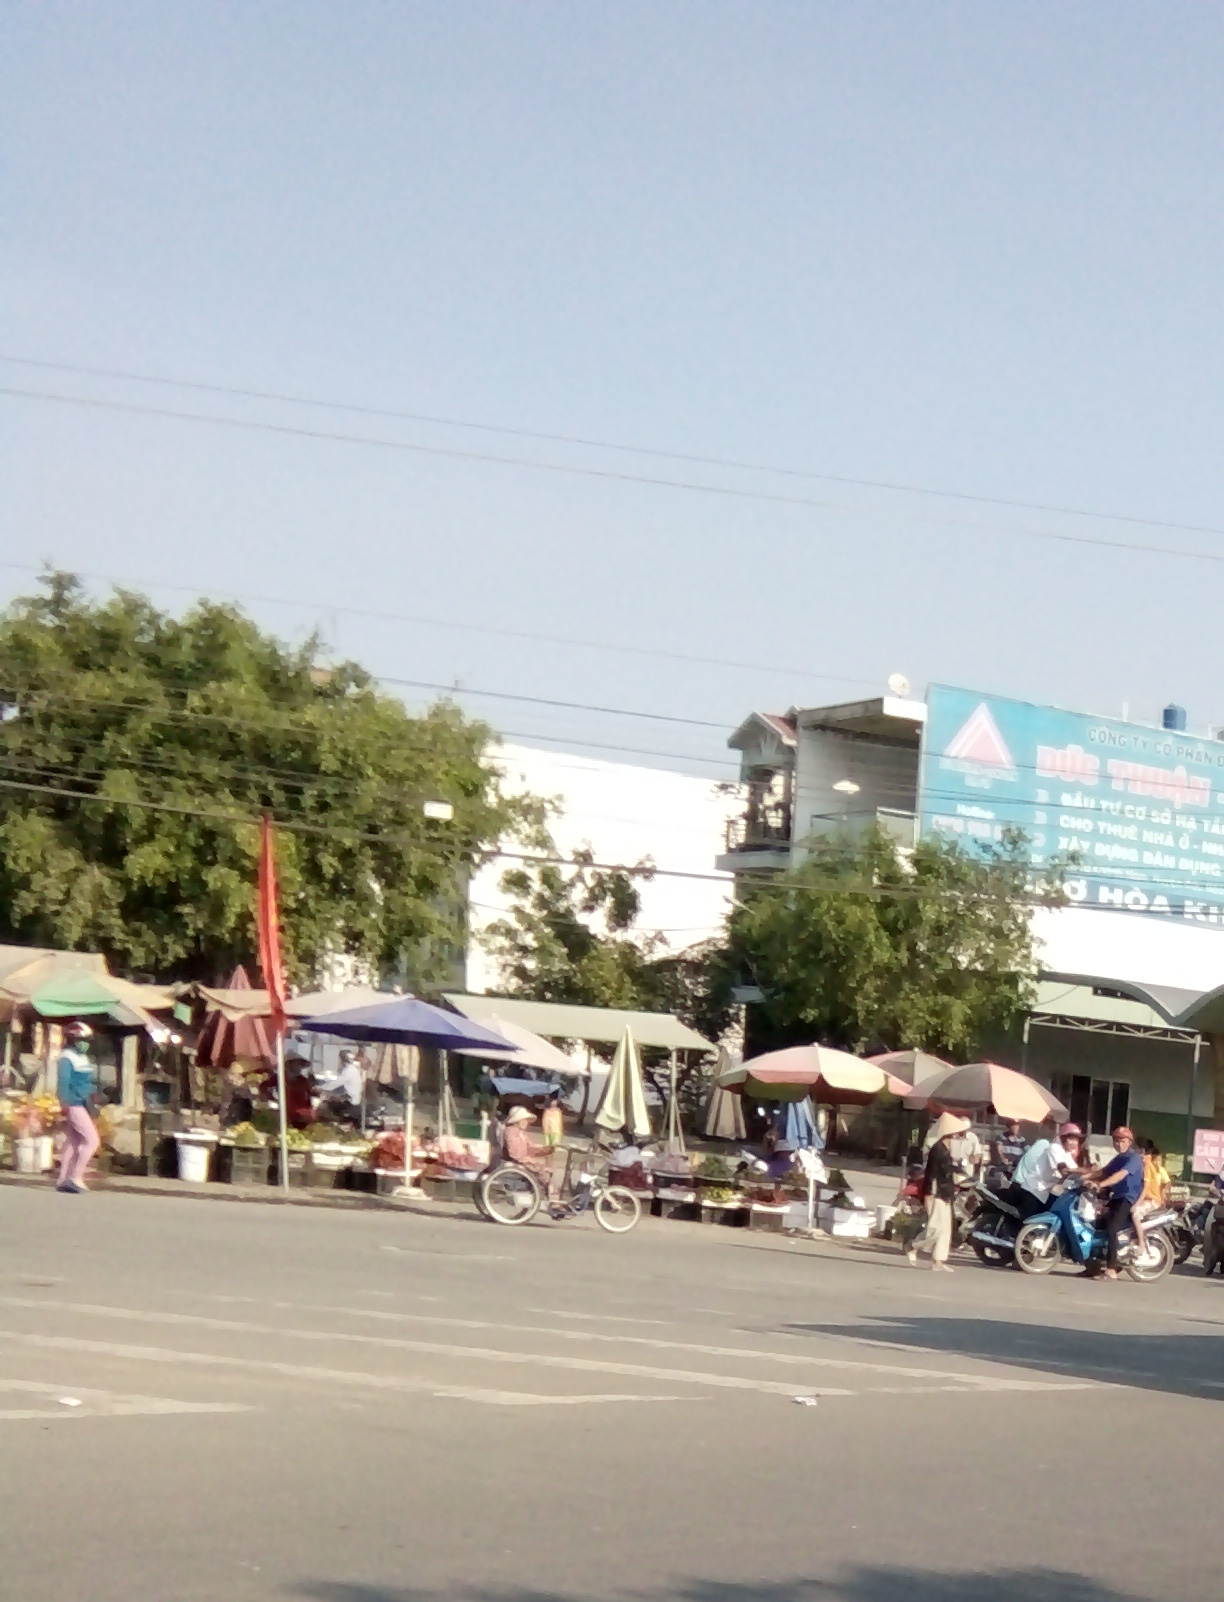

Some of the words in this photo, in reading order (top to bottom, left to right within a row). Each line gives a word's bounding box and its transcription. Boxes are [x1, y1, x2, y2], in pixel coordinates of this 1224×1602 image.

[1132, 736, 1148, 750] TY
[1060, 815, 1093, 833] CHO
[1098, 820, 1138, 841] THUÊ
